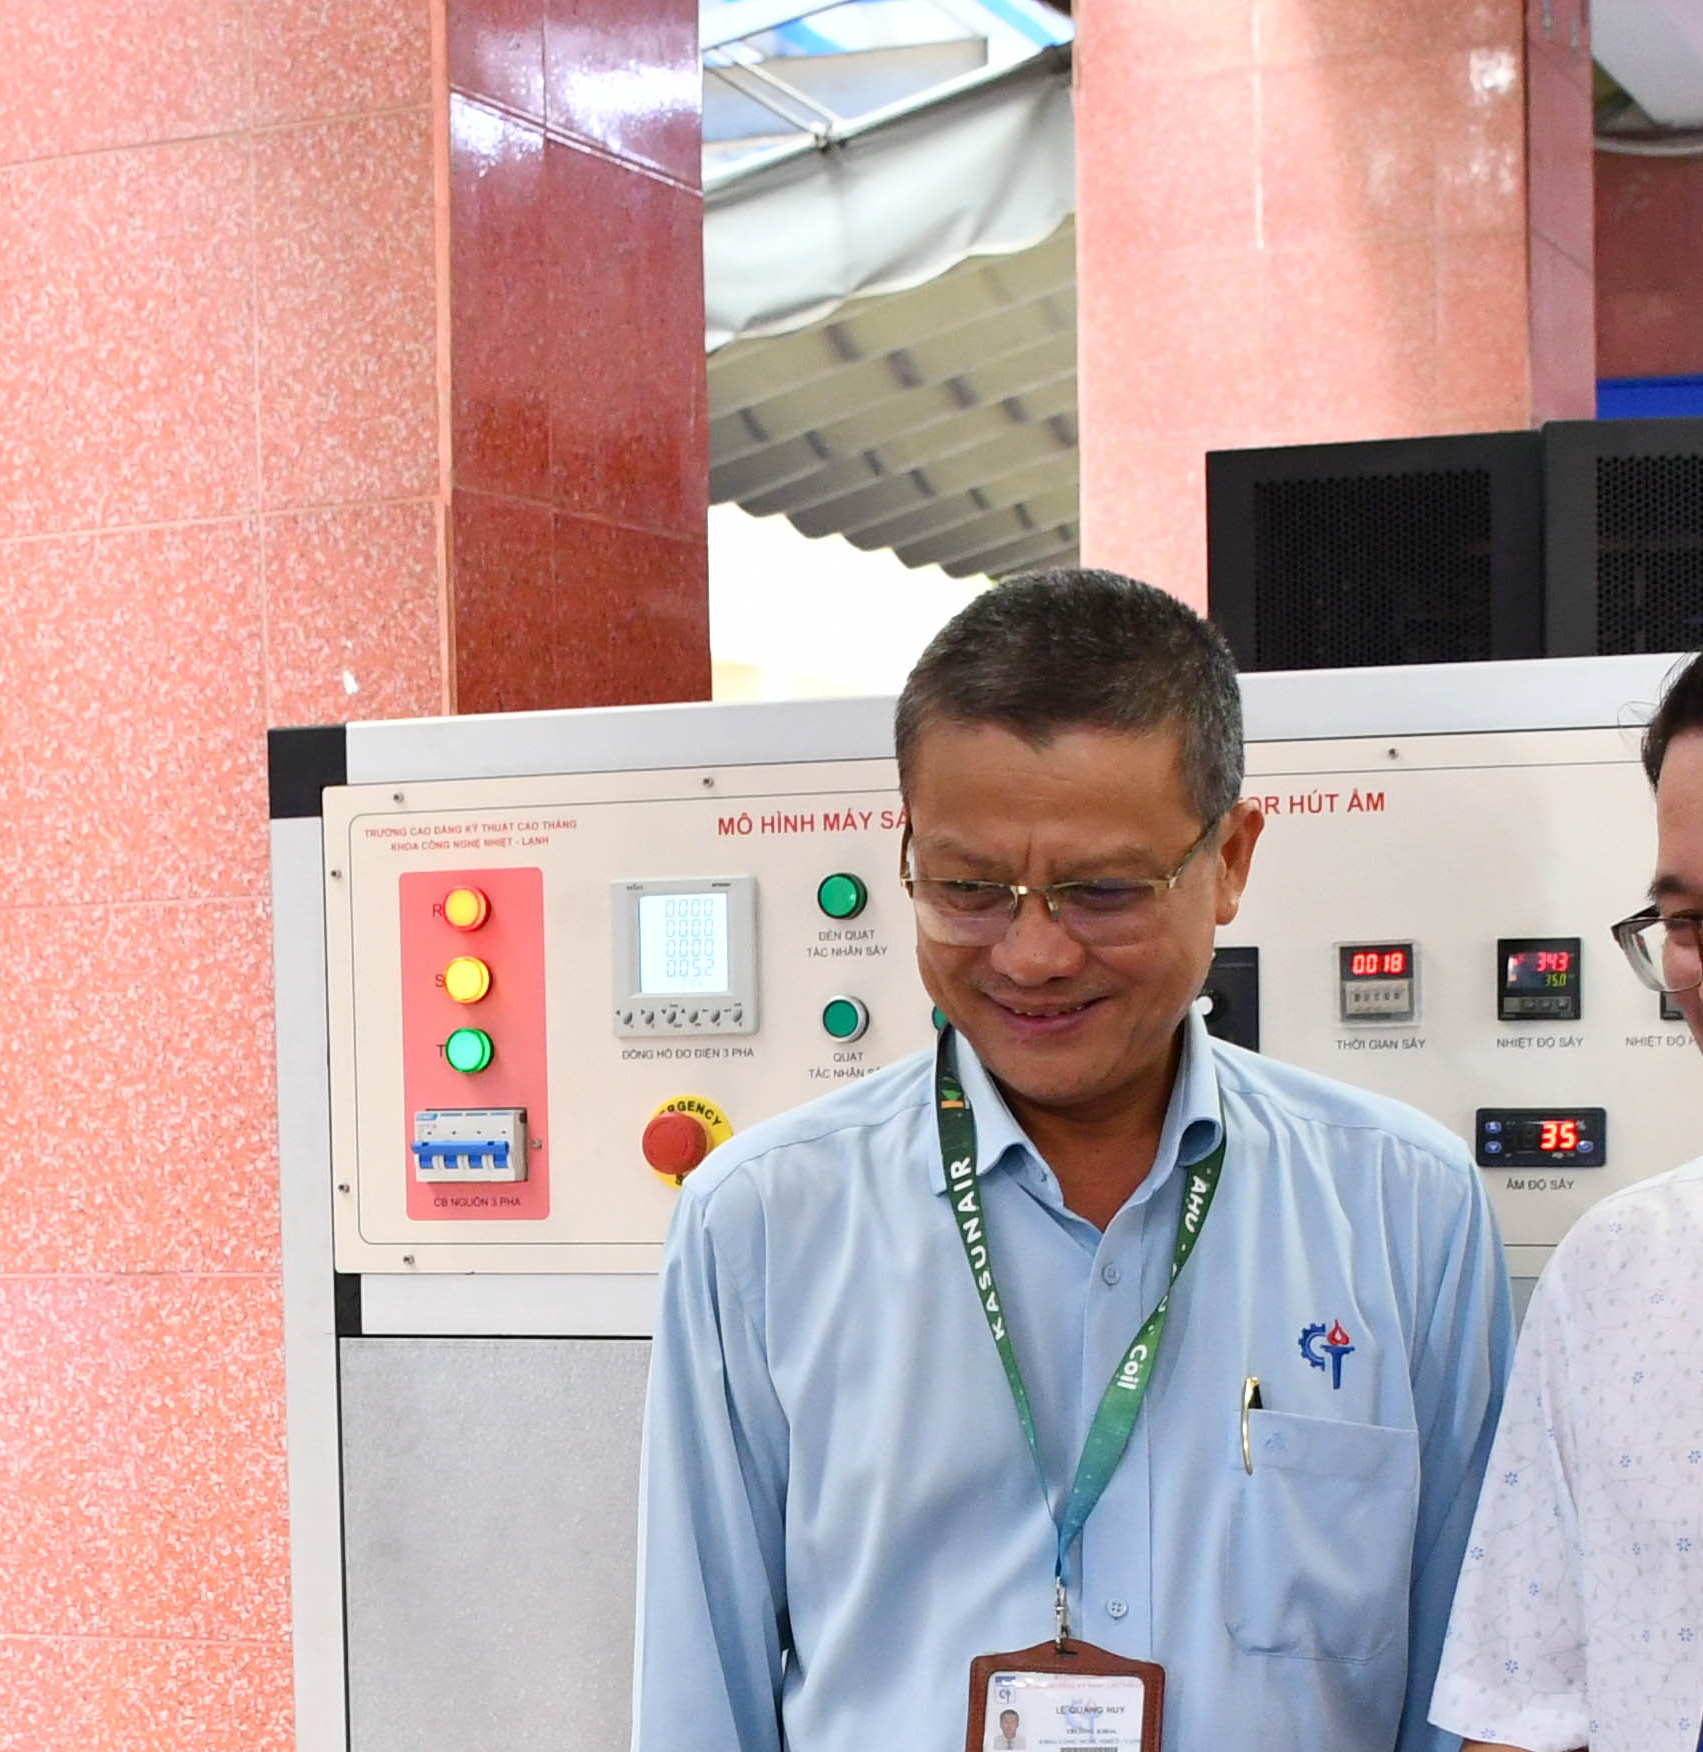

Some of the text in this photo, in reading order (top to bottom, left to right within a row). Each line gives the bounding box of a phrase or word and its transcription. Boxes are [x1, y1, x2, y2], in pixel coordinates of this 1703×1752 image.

[1289, 789, 1339, 814] HÚT
[718, 812, 753, 836] MÔ
[761, 810, 815, 834] HÌNH
[1352, 952, 1403, 975] 0018
[1540, 1120, 1576, 1151] 35
[950, 1156, 1005, 1340] KASUNAIR
[1117, 1344, 1147, 1390] Coil
